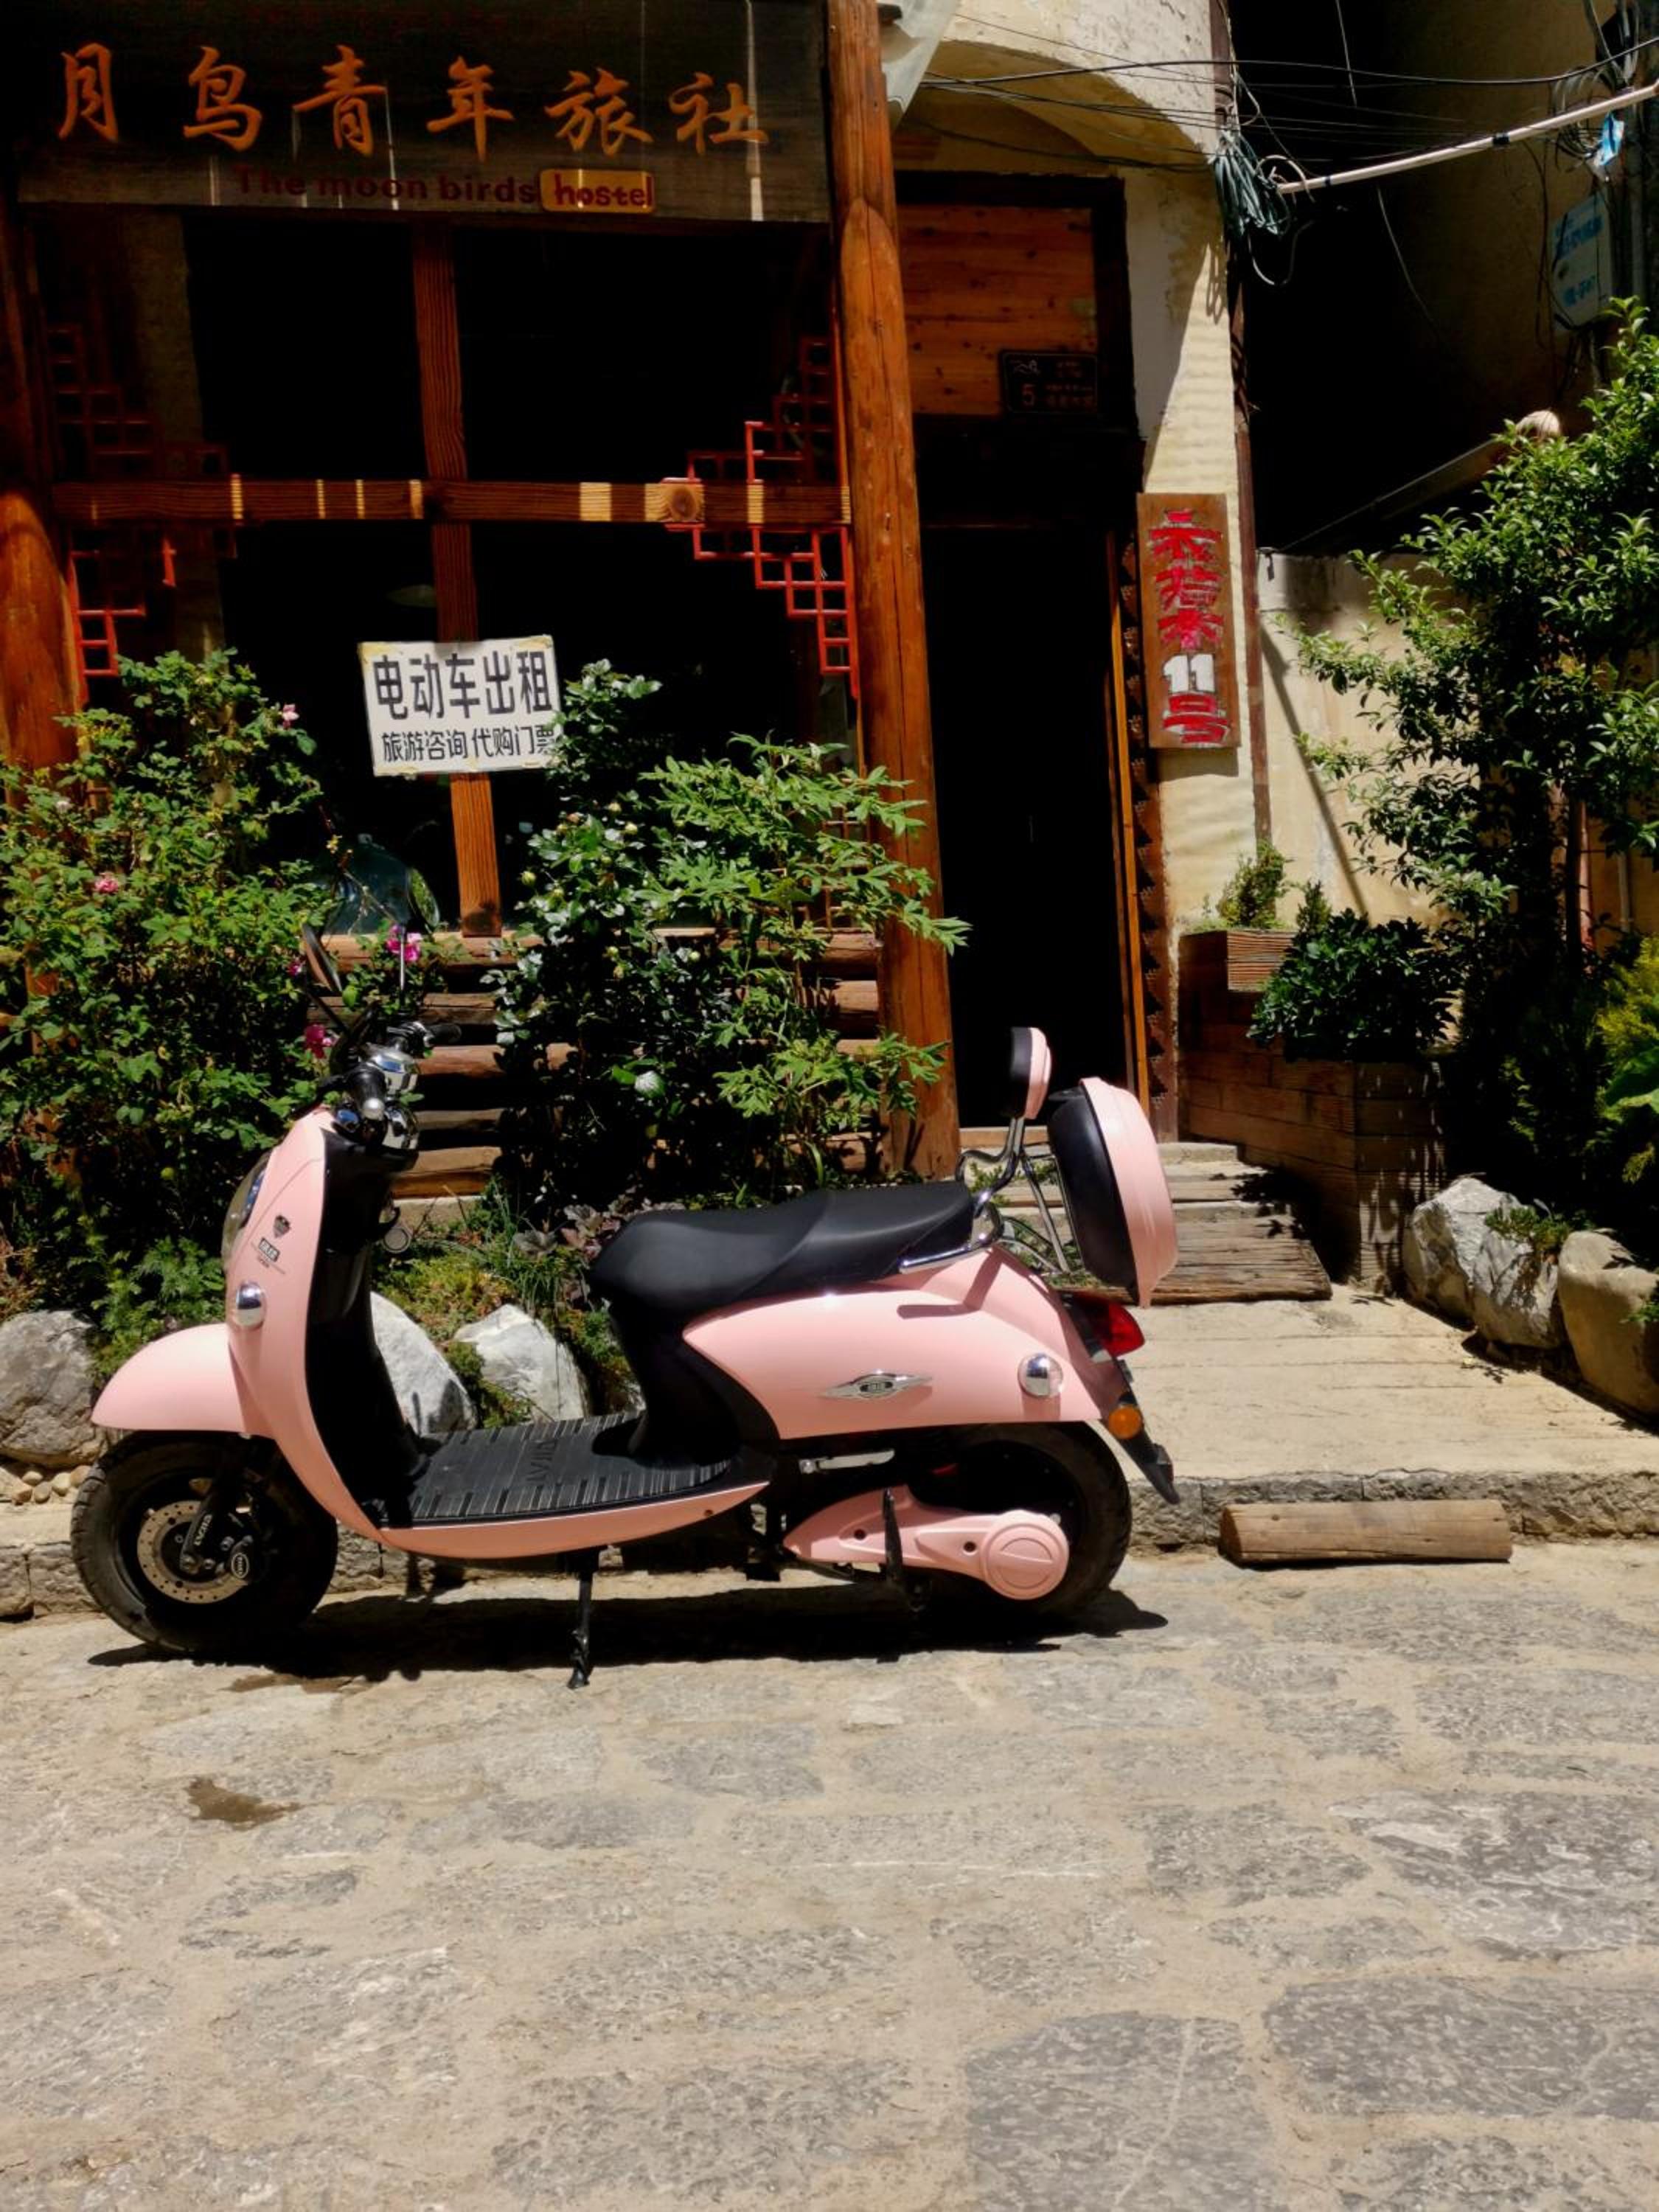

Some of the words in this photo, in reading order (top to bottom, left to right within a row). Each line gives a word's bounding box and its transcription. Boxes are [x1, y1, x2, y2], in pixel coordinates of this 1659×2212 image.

[59, 43, 768, 161] 月鸟青年旅社
[237, 165, 306, 196] The
[316, 175, 427, 201] moon
[442, 175, 535, 204] birds
[554, 173, 653, 207] hostel
[373, 650, 552, 720] 电动车出租
[381, 728, 468, 763] 旅游咨询
